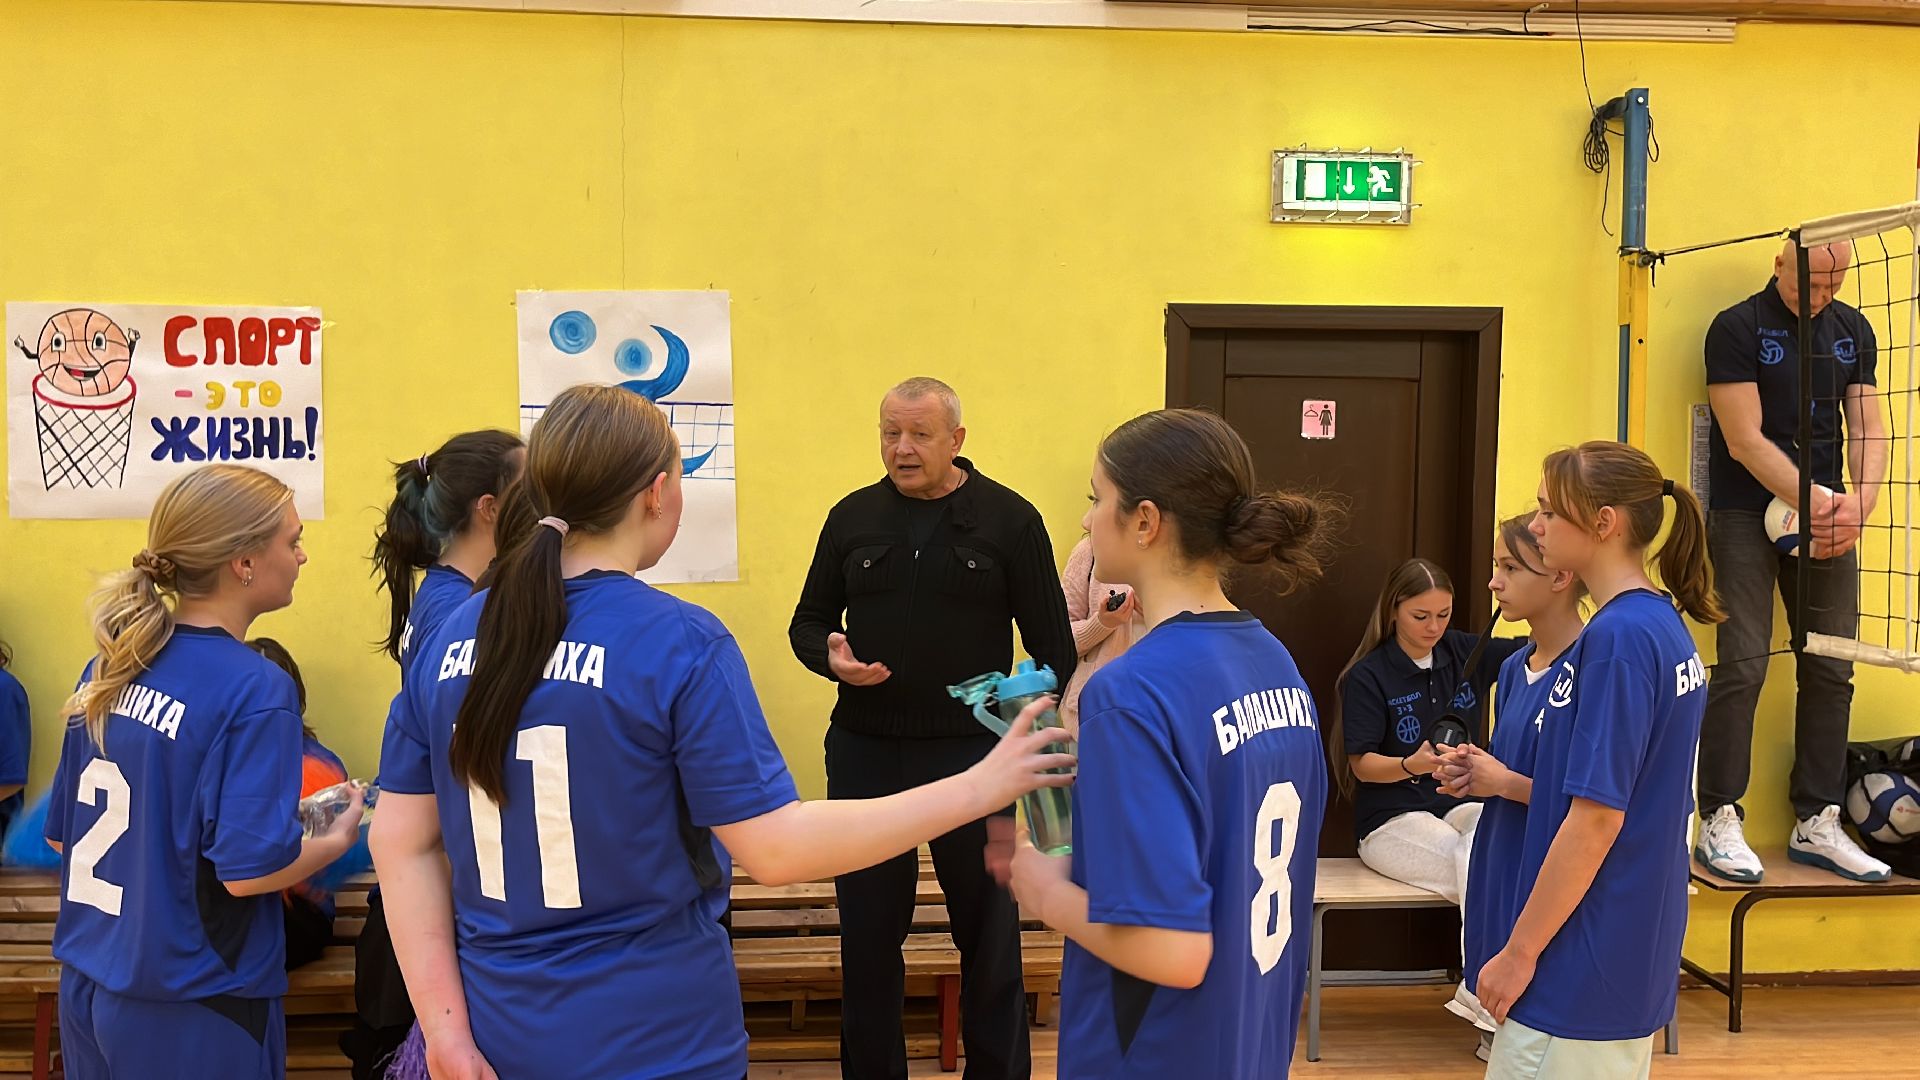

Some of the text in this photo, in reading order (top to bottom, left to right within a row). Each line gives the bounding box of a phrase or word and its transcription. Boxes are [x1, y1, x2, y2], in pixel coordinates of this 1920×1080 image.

[163, 314, 321, 367] СПОРТ
[205, 379, 282, 410] ЭТО
[151, 406, 318, 462] ЖИЗНЬ!
[437, 635, 605, 689] БАИХА
[82, 682, 186, 740] ШИХА
[67, 757, 131, 916] 2
[1251, 781, 1302, 976] 8
